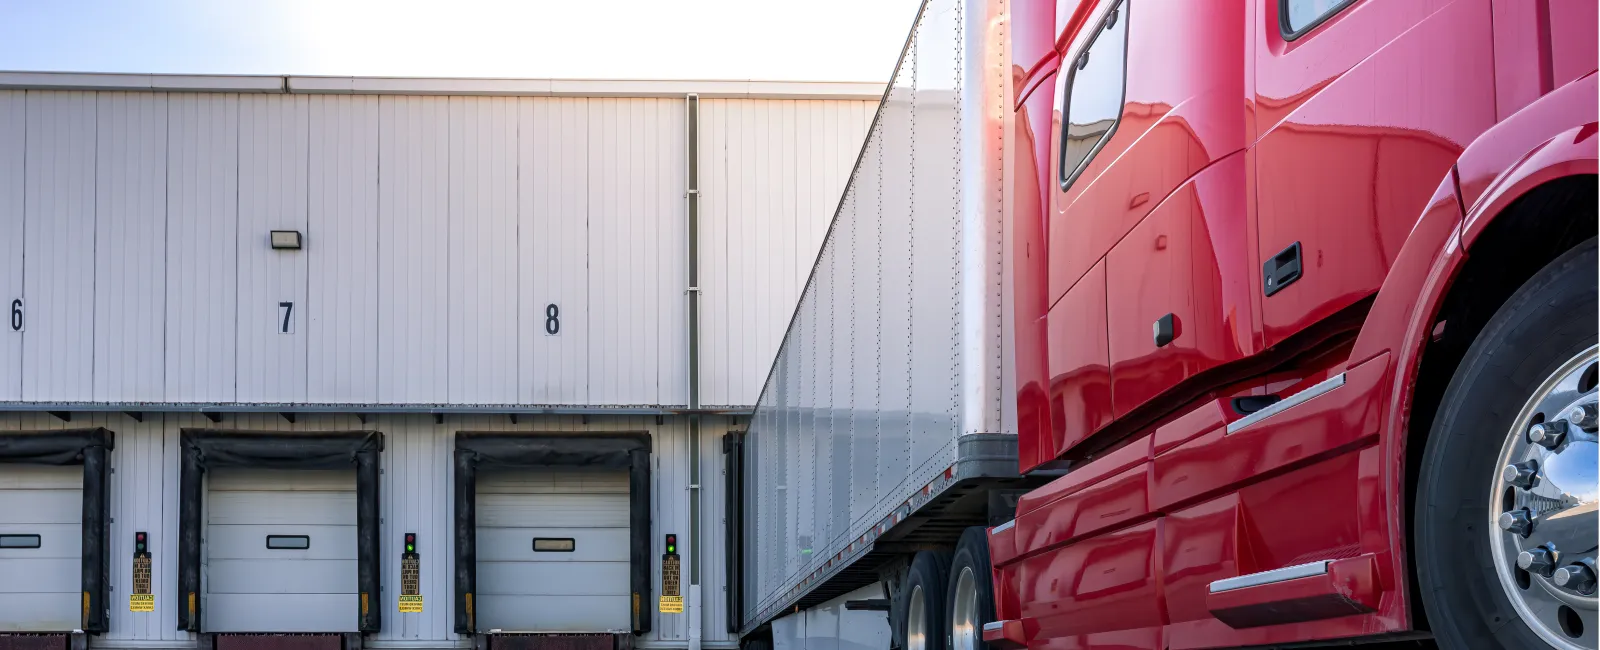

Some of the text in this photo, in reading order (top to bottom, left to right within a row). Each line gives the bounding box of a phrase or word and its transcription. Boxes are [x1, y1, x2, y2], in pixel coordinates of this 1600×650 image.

[11, 298, 23, 332] 6
[279, 301, 294, 333] 7
[545, 303, 560, 335] 8
